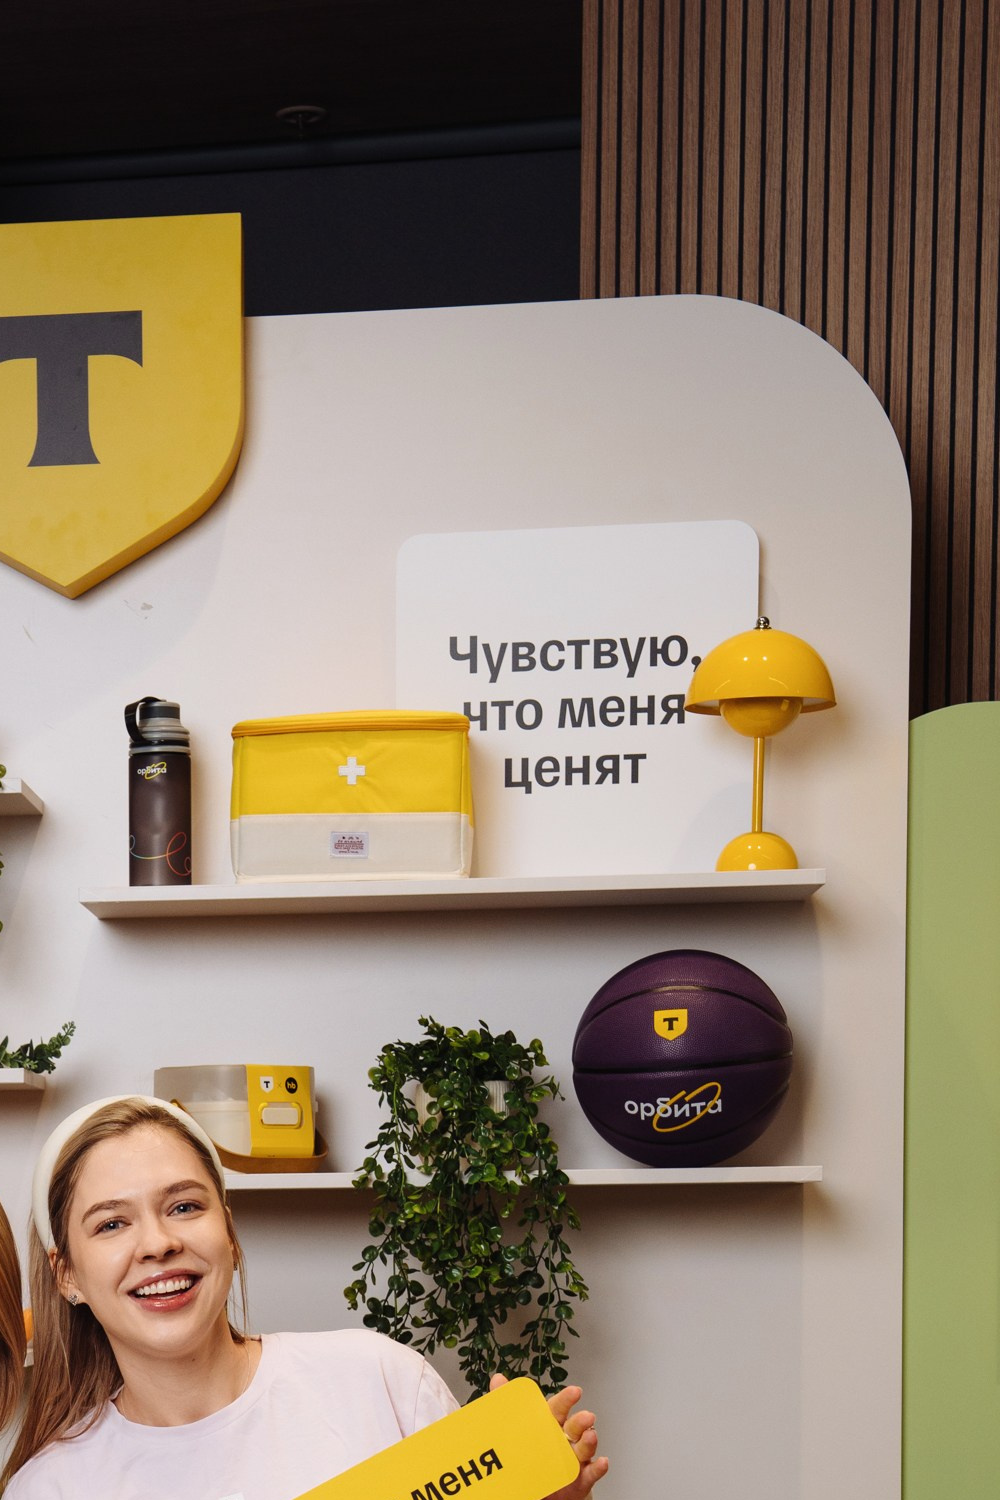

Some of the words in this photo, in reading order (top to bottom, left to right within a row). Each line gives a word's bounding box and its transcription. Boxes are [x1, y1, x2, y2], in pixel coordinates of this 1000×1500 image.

[449, 634, 702, 684] Чувствую,
[463, 699, 543, 731] что
[557, 694, 686, 729] меня
[504, 753, 647, 795] ценят
[624, 1095, 723, 1122] орбита
